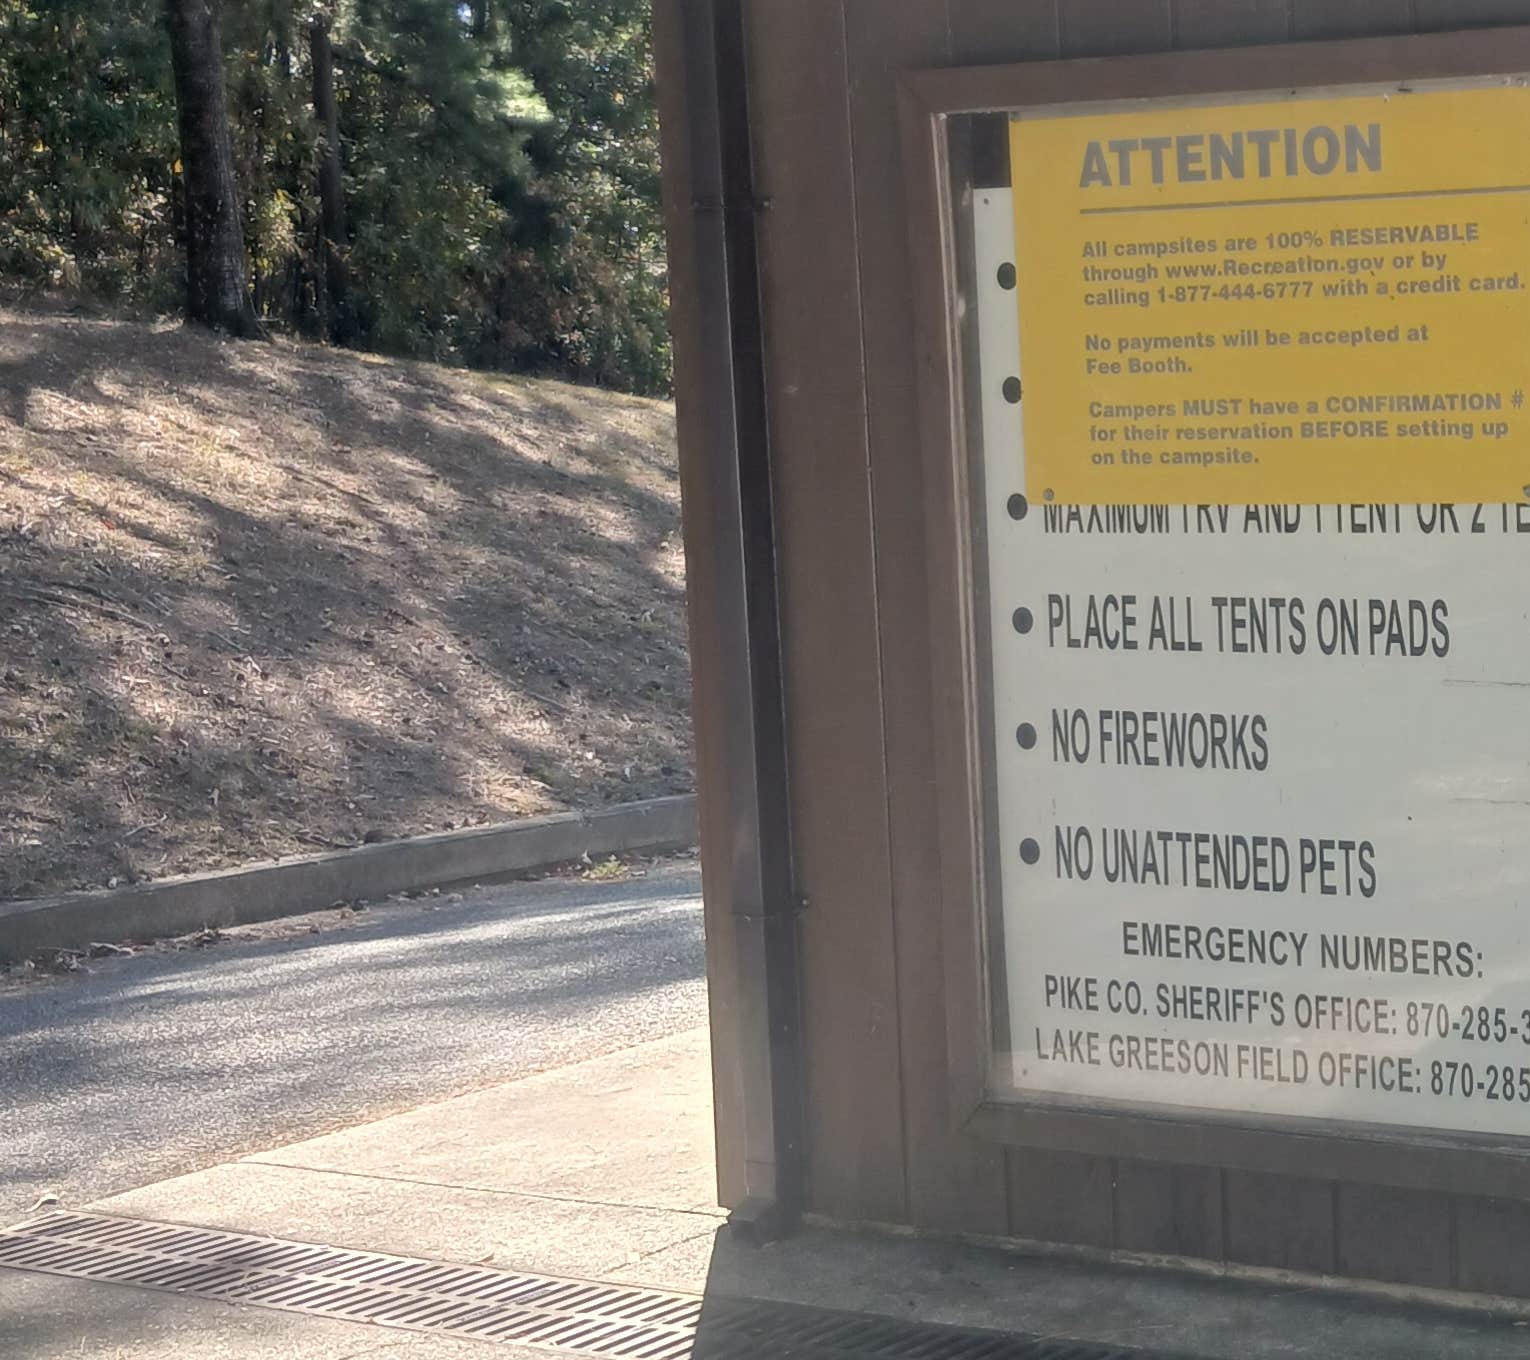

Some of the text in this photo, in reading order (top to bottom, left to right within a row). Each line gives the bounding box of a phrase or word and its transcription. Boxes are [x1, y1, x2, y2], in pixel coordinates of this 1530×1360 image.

[1080, 123, 1382, 188] ATTENTION
[1082, 223, 1479, 261] All campsites are 100% RESERVABLE
[1082, 251, 1447, 283] through www.Recreation.gov or by
[1084, 272, 1525, 307] calling 1-877-444-6777 with a credit card.
[1086, 325, 1428, 353] No payments will be accepted at
[1086, 356, 1192, 374] Fee Booth.
[1089, 389, 1524, 420] Campers MUST have a CONFIRMATION #
[1089, 418, 1508, 441] for their reservation BEFORE setting up
[1091, 447, 1259, 467] on the campsite.
[1048, 594, 1450, 658] PLACE ALL TENTS ON PADS
[1051, 708, 1269, 771] NO FIREWORKS
[1054, 825, 1377, 898] NO UNATTENDED PETS
[1122, 921, 1484, 979] EMERGENCY NUMBERS:
[1045, 974, 1099, 1011] PIKE
[1107, 979, 1147, 1016] CO.
[1156, 983, 1286, 1027] SHERIFF'S
[1294, 993, 1397, 1035] OFFICE:
[1036, 1027, 1101, 1065] LAKE
[1108, 1033, 1229, 1077] GREESON
[1237, 1044, 1308, 1084] FIELD
[1318, 1050, 1421, 1093] OFFICE:
